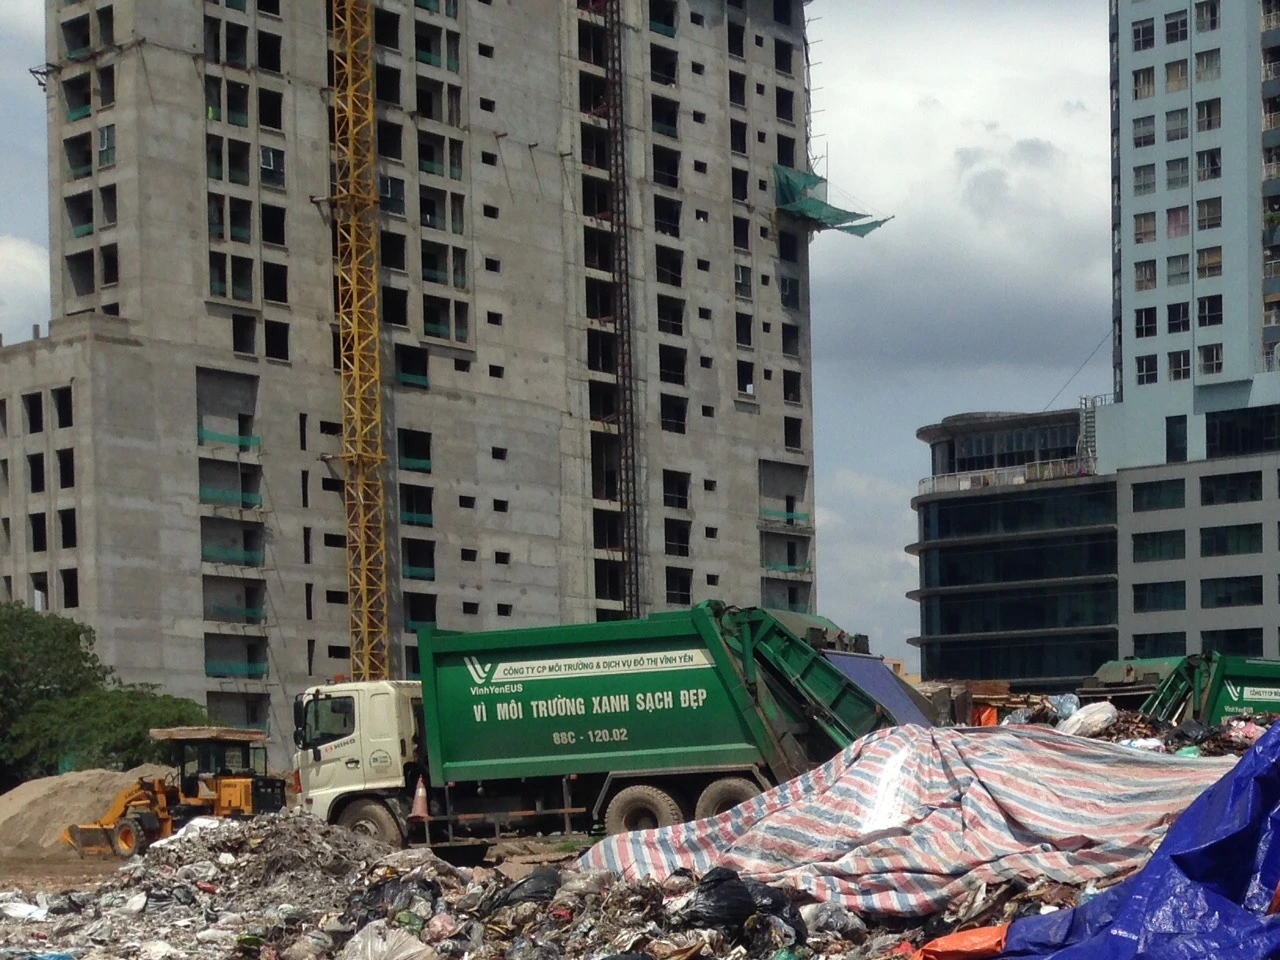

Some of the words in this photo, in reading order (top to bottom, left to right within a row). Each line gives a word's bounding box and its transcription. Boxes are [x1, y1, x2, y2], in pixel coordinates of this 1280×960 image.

[503, 666, 524, 676] CÔNG
[526, 666, 535, 675] TY
[536, 665, 547, 675] CP
[548, 663, 562, 673] MÔI
[595, 661, 601, 669] &
[603, 660, 620, 671] DỊCH
[646, 658, 658, 667] THỊ
[470, 684, 523, 695] VinhYenEUS
[473, 701, 487, 722] VÌ
[496, 699, 523, 721] MÔI
[530, 694, 586, 719] TRƯỜNG
[592, 694, 630, 714] XANH
[636, 691, 674, 714] SẠCH
[680, 689, 707, 710] ĐẸP
[552, 731, 576, 745] 88C
[588, 728, 629, 743] 120.02
